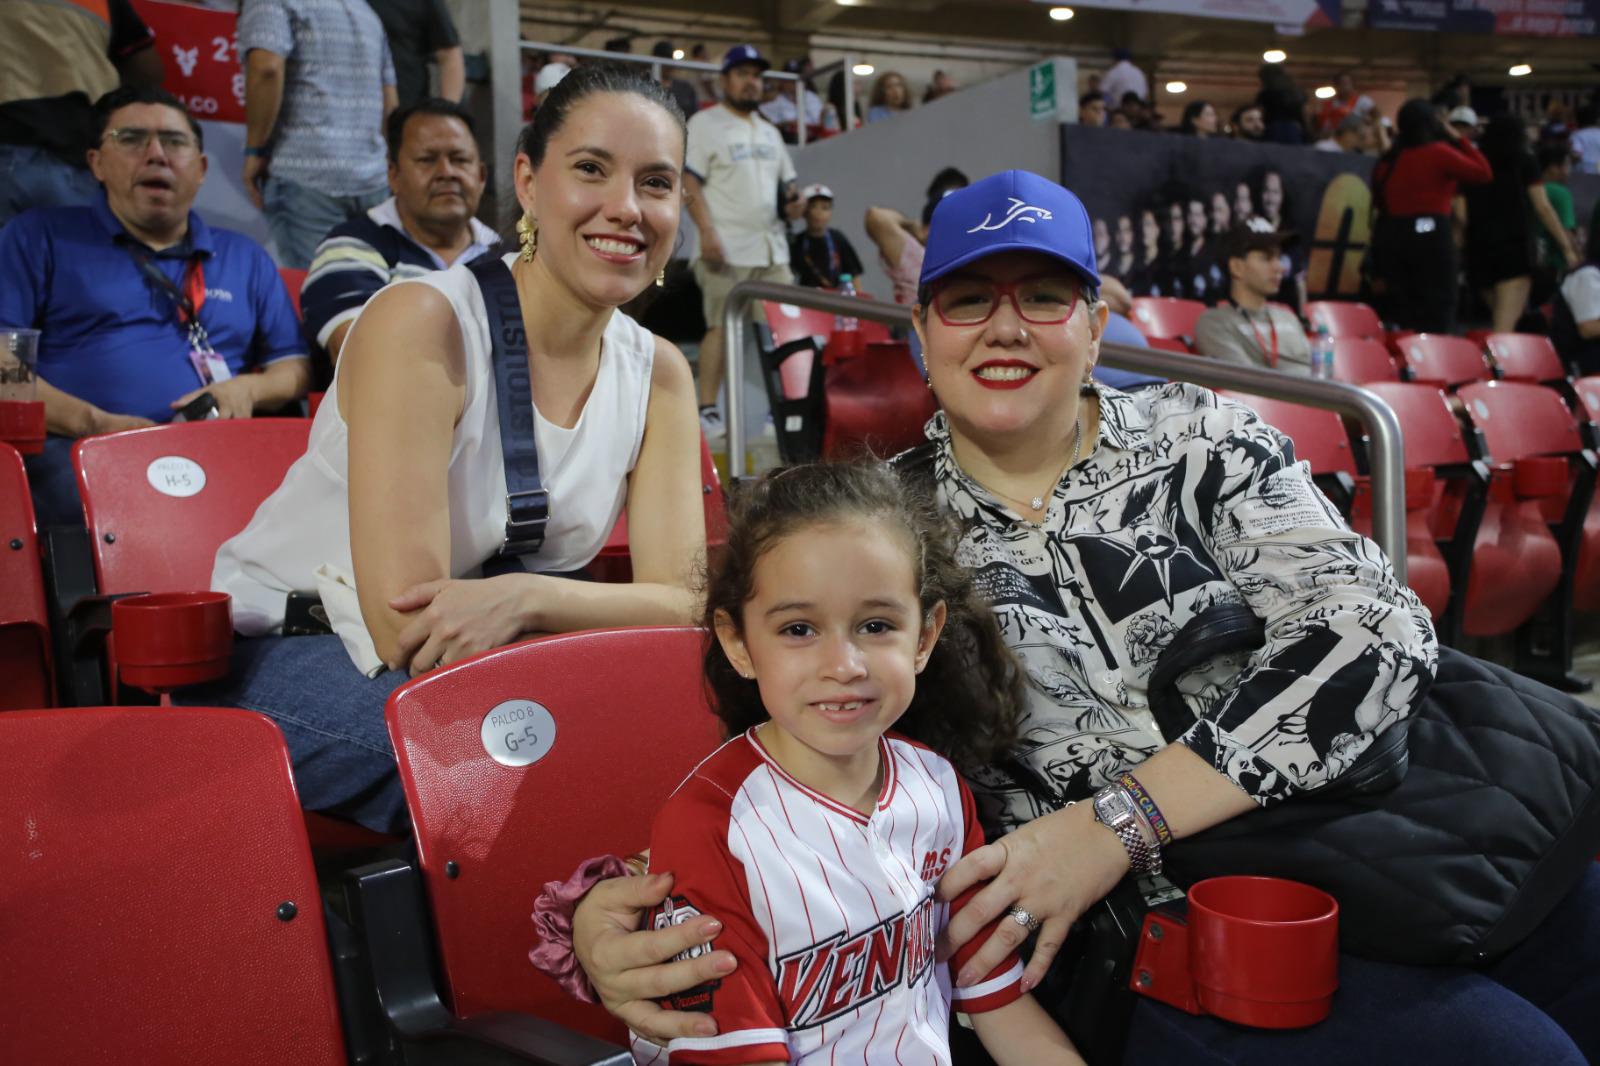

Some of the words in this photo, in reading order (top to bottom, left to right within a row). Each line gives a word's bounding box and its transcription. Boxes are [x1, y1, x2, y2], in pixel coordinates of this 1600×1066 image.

[491, 708, 525, 728] PALCO
[526, 706, 534, 717] 8
[504, 726, 538, 752] G-5
